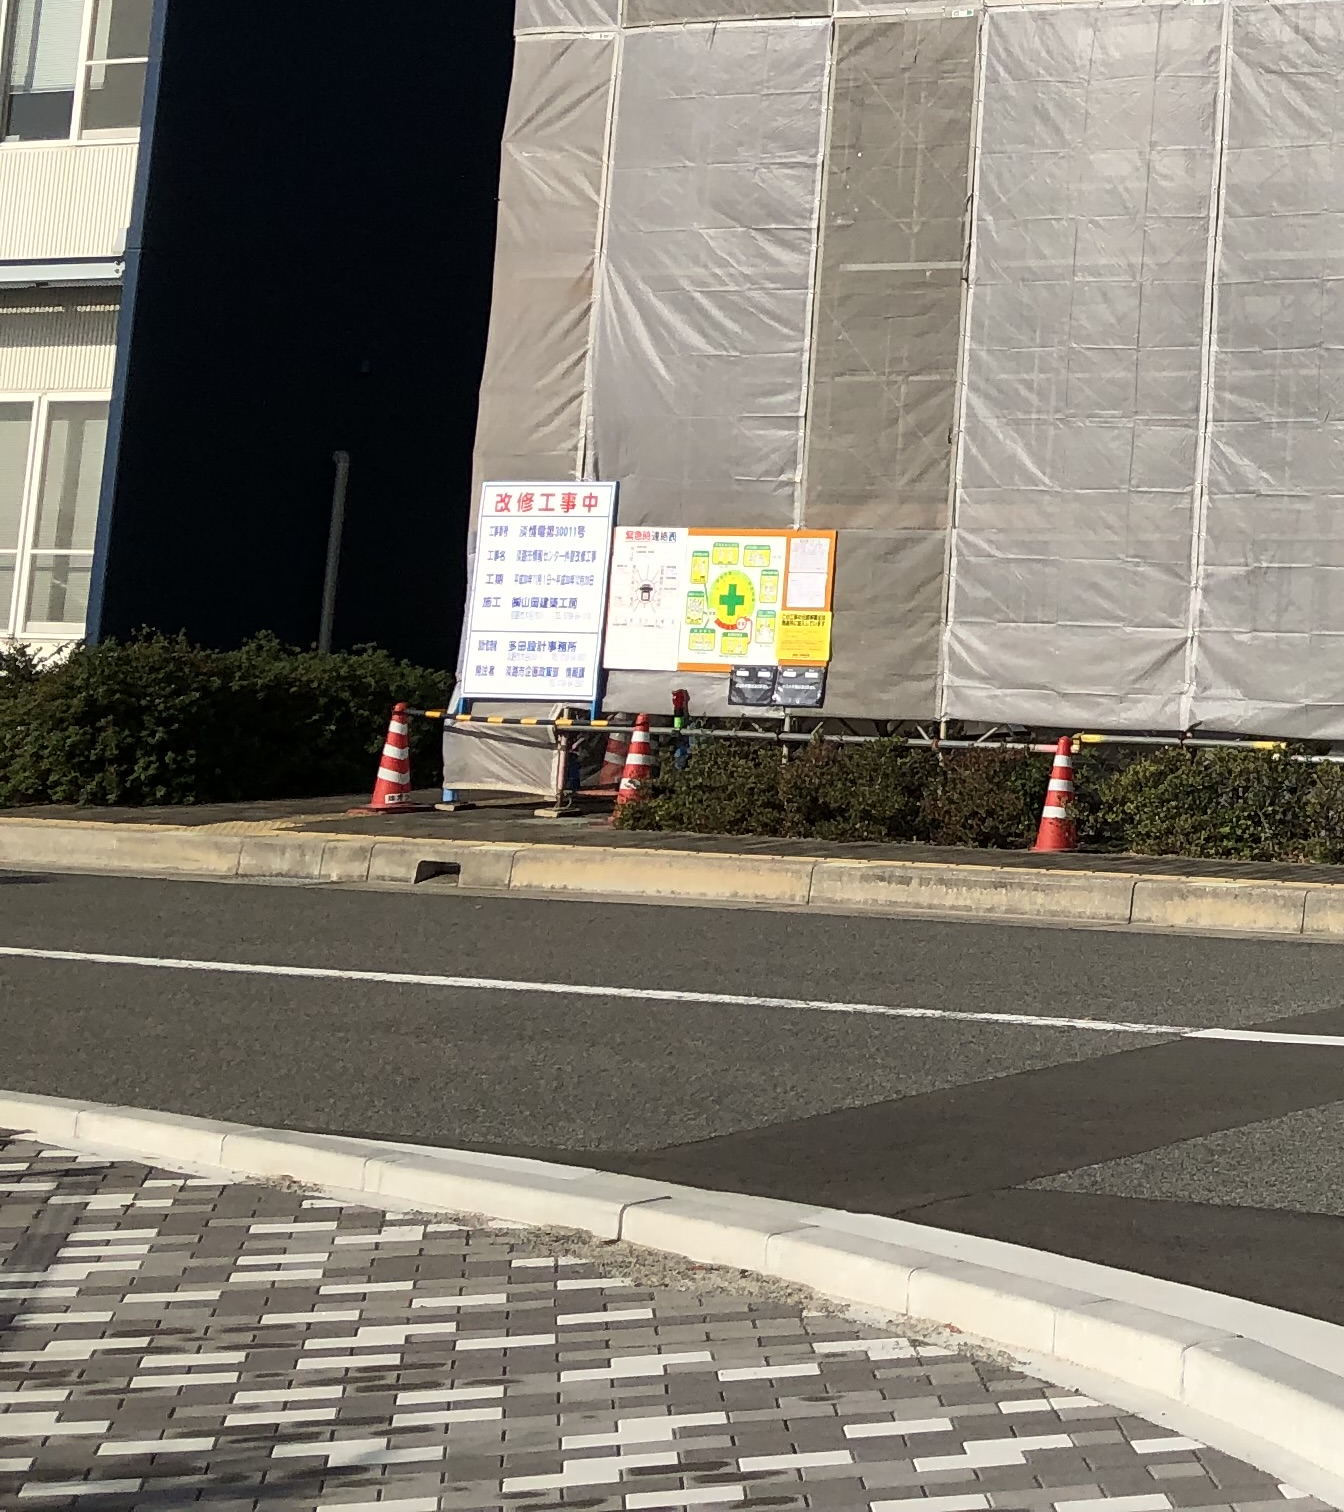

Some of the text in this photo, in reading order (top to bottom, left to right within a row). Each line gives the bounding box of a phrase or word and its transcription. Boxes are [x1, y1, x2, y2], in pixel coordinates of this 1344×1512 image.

[494, 492, 598, 513] 改修工事中
[484, 573, 504, 585] 工期
[482, 597, 502, 608] 施工
[508, 640, 577, 652] 多田設計事務所
